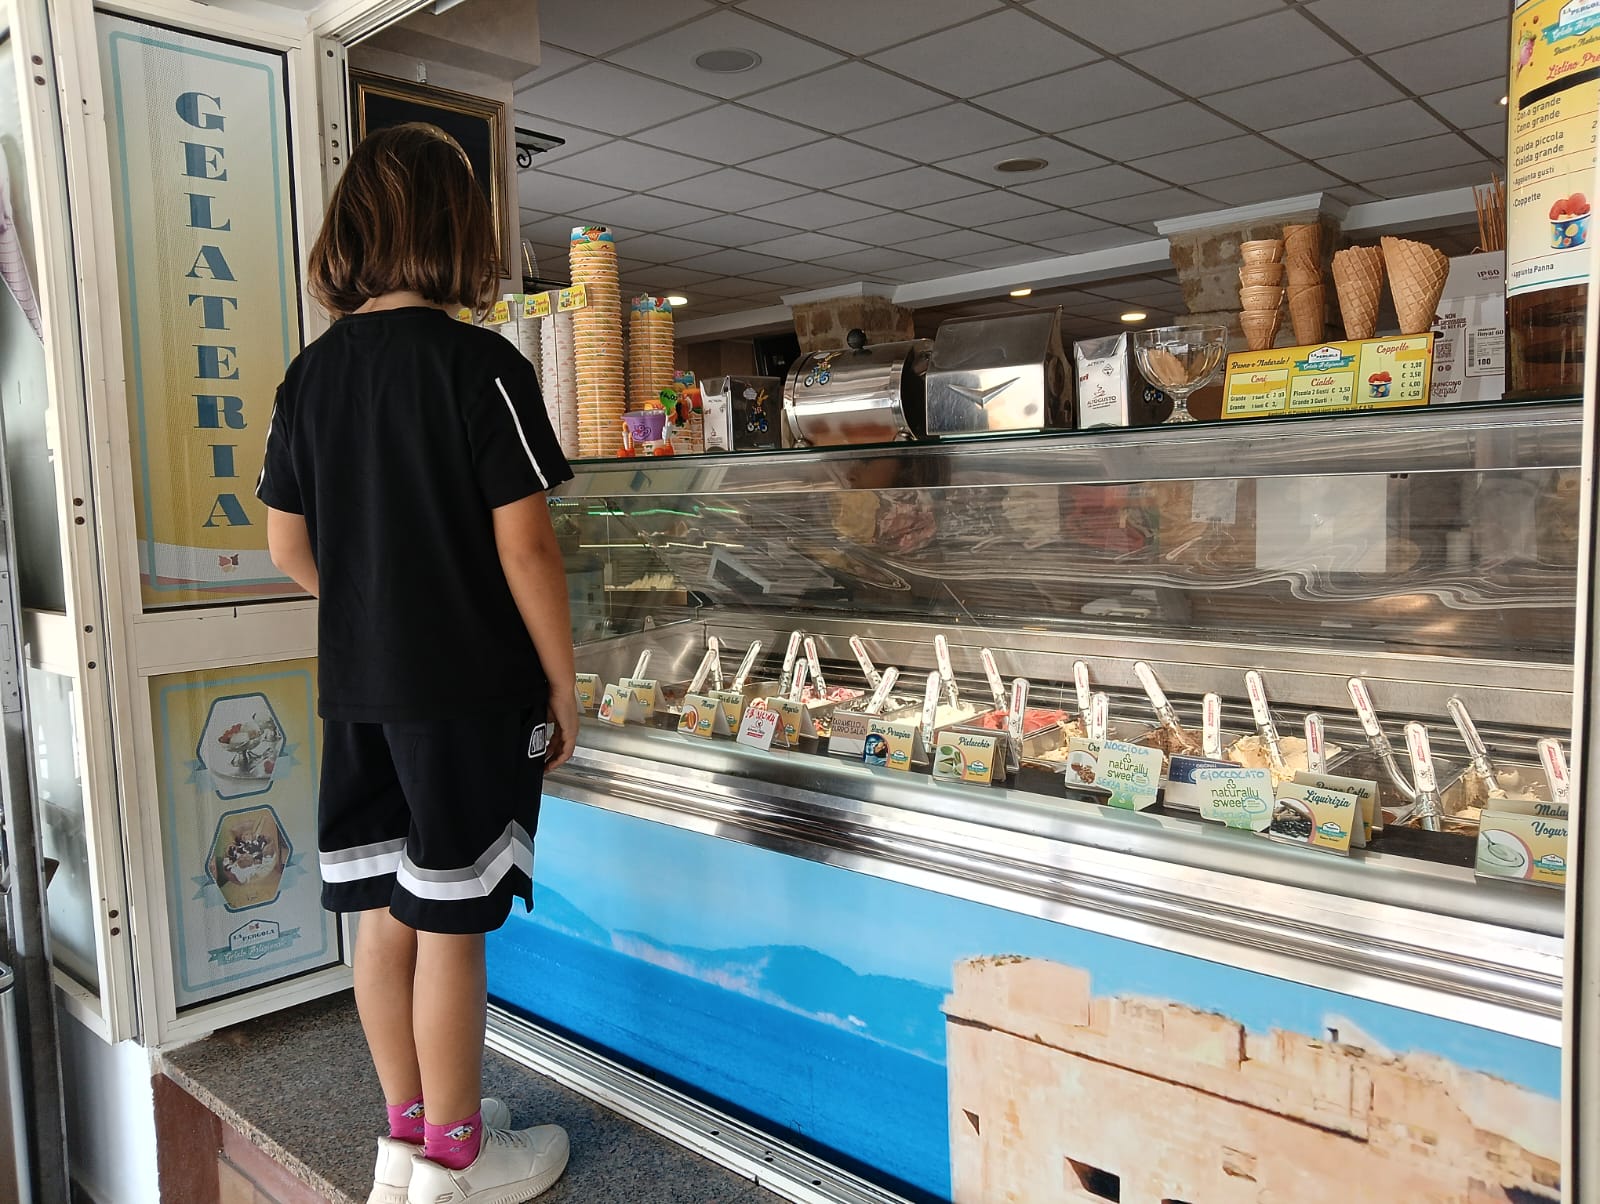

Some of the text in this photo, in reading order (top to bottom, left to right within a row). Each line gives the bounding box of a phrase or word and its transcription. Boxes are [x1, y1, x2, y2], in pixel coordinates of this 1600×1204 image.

[1532, 97, 1561, 116] grande
[1532, 110, 1561, 129] grande
[1535, 131, 1564, 148] piccola
[1534, 144, 1564, 162] grande
[1514, 193, 1541, 208] Coppette
[1533, 263, 1554, 273] Panna
[175, 91, 253, 528] GELATERIA
[957, 736, 991, 751] Pistacchio
[1104, 741, 1150, 756] NOCCIOLA
[1107, 769, 1136, 783] sweet
[1108, 759, 1149, 778] naturally
[1210, 786, 1259, 800] naturally
[1302, 789, 1352, 809] Liquirizia
[1212, 797, 1247, 808] sweet
